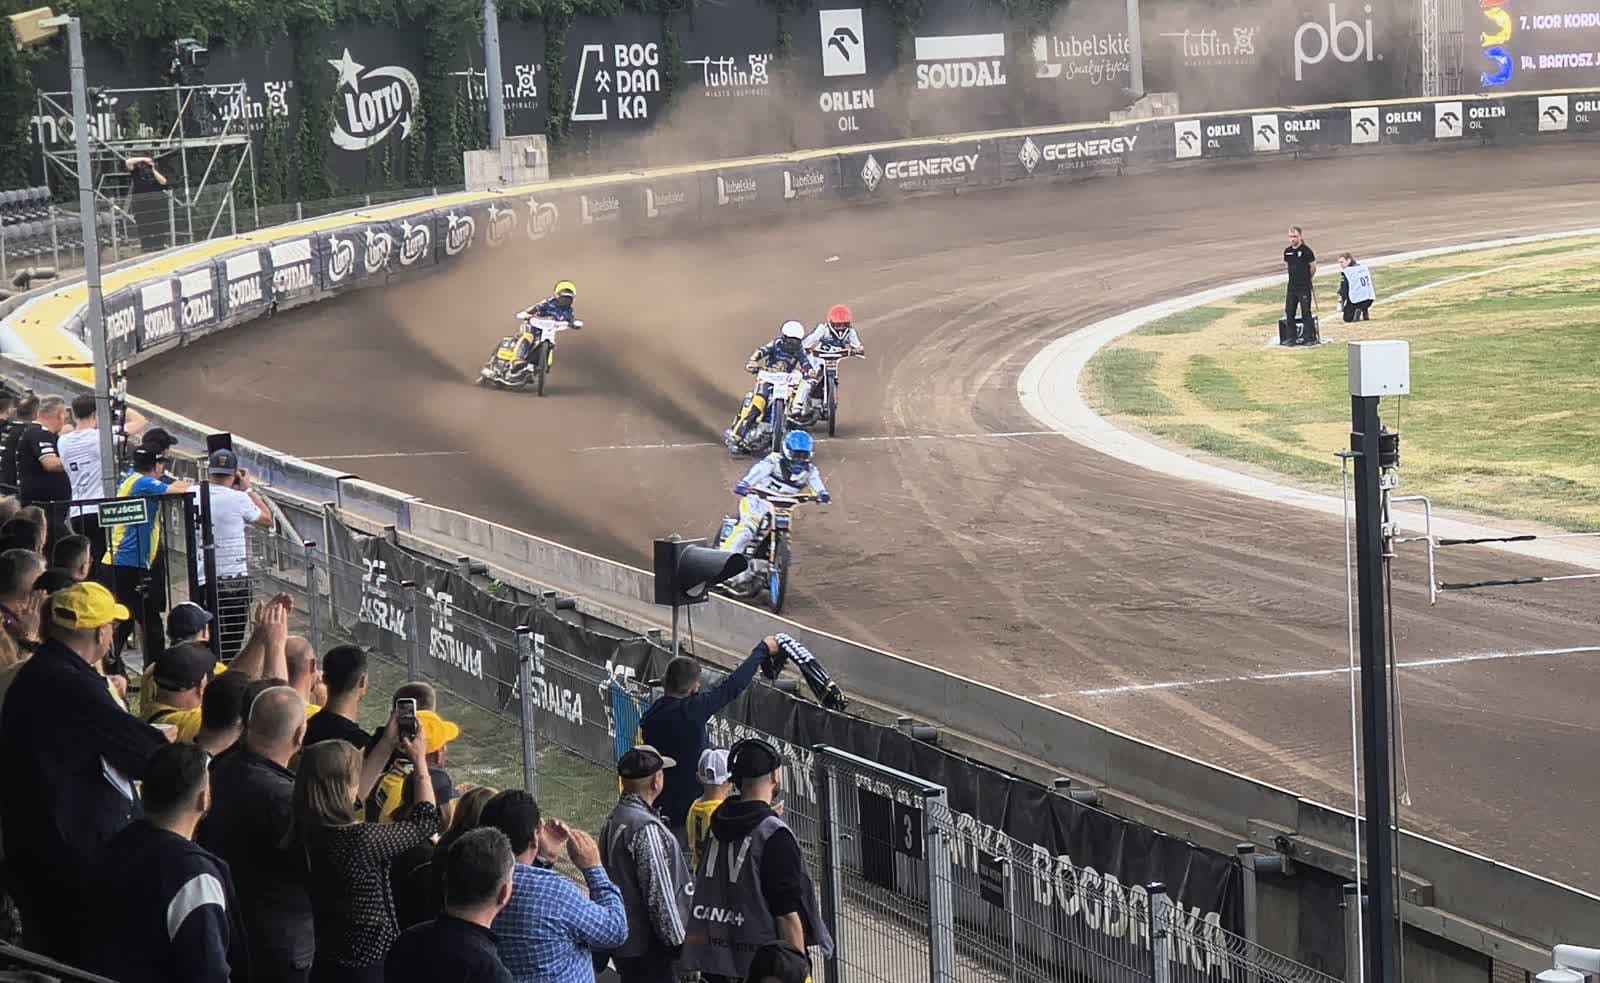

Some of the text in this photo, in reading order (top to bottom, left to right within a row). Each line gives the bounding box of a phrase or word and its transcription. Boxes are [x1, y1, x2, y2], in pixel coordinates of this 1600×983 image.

[1533, 14, 1561, 29] IGOR
[614, 43, 659, 67] BOG
[1539, 53, 1593, 69] BARTOSZ
[616, 69, 660, 93] DAN
[916, 61, 1006, 89] SOUDAL
[345, 81, 402, 133] LOTTO
[618, 95, 648, 119] KA
[820, 90, 874, 112] ORLEN
[1469, 107, 1506, 118] ORLEN
[838, 117, 859, 131] OIL
[1284, 119, 1321, 132] ORLEN
[1385, 112, 1422, 124] ORLEN
[1469, 121, 1483, 129] OIL
[1575, 114, 1589, 123] OIL
[1206, 124, 1241, 137] ORLEN
[1385, 126, 1400, 135] OIL
[1043, 135, 1138, 161] GCENERGY
[885, 154, 979, 179] GCENERGY
[272, 263, 313, 293] SOUDAL
[228, 276, 262, 307] SOUDAL
[143, 306, 175, 340] SOUDAL
[903, 813, 913, 850] 3
[1032, 843, 1231, 981] BOGDAKA
